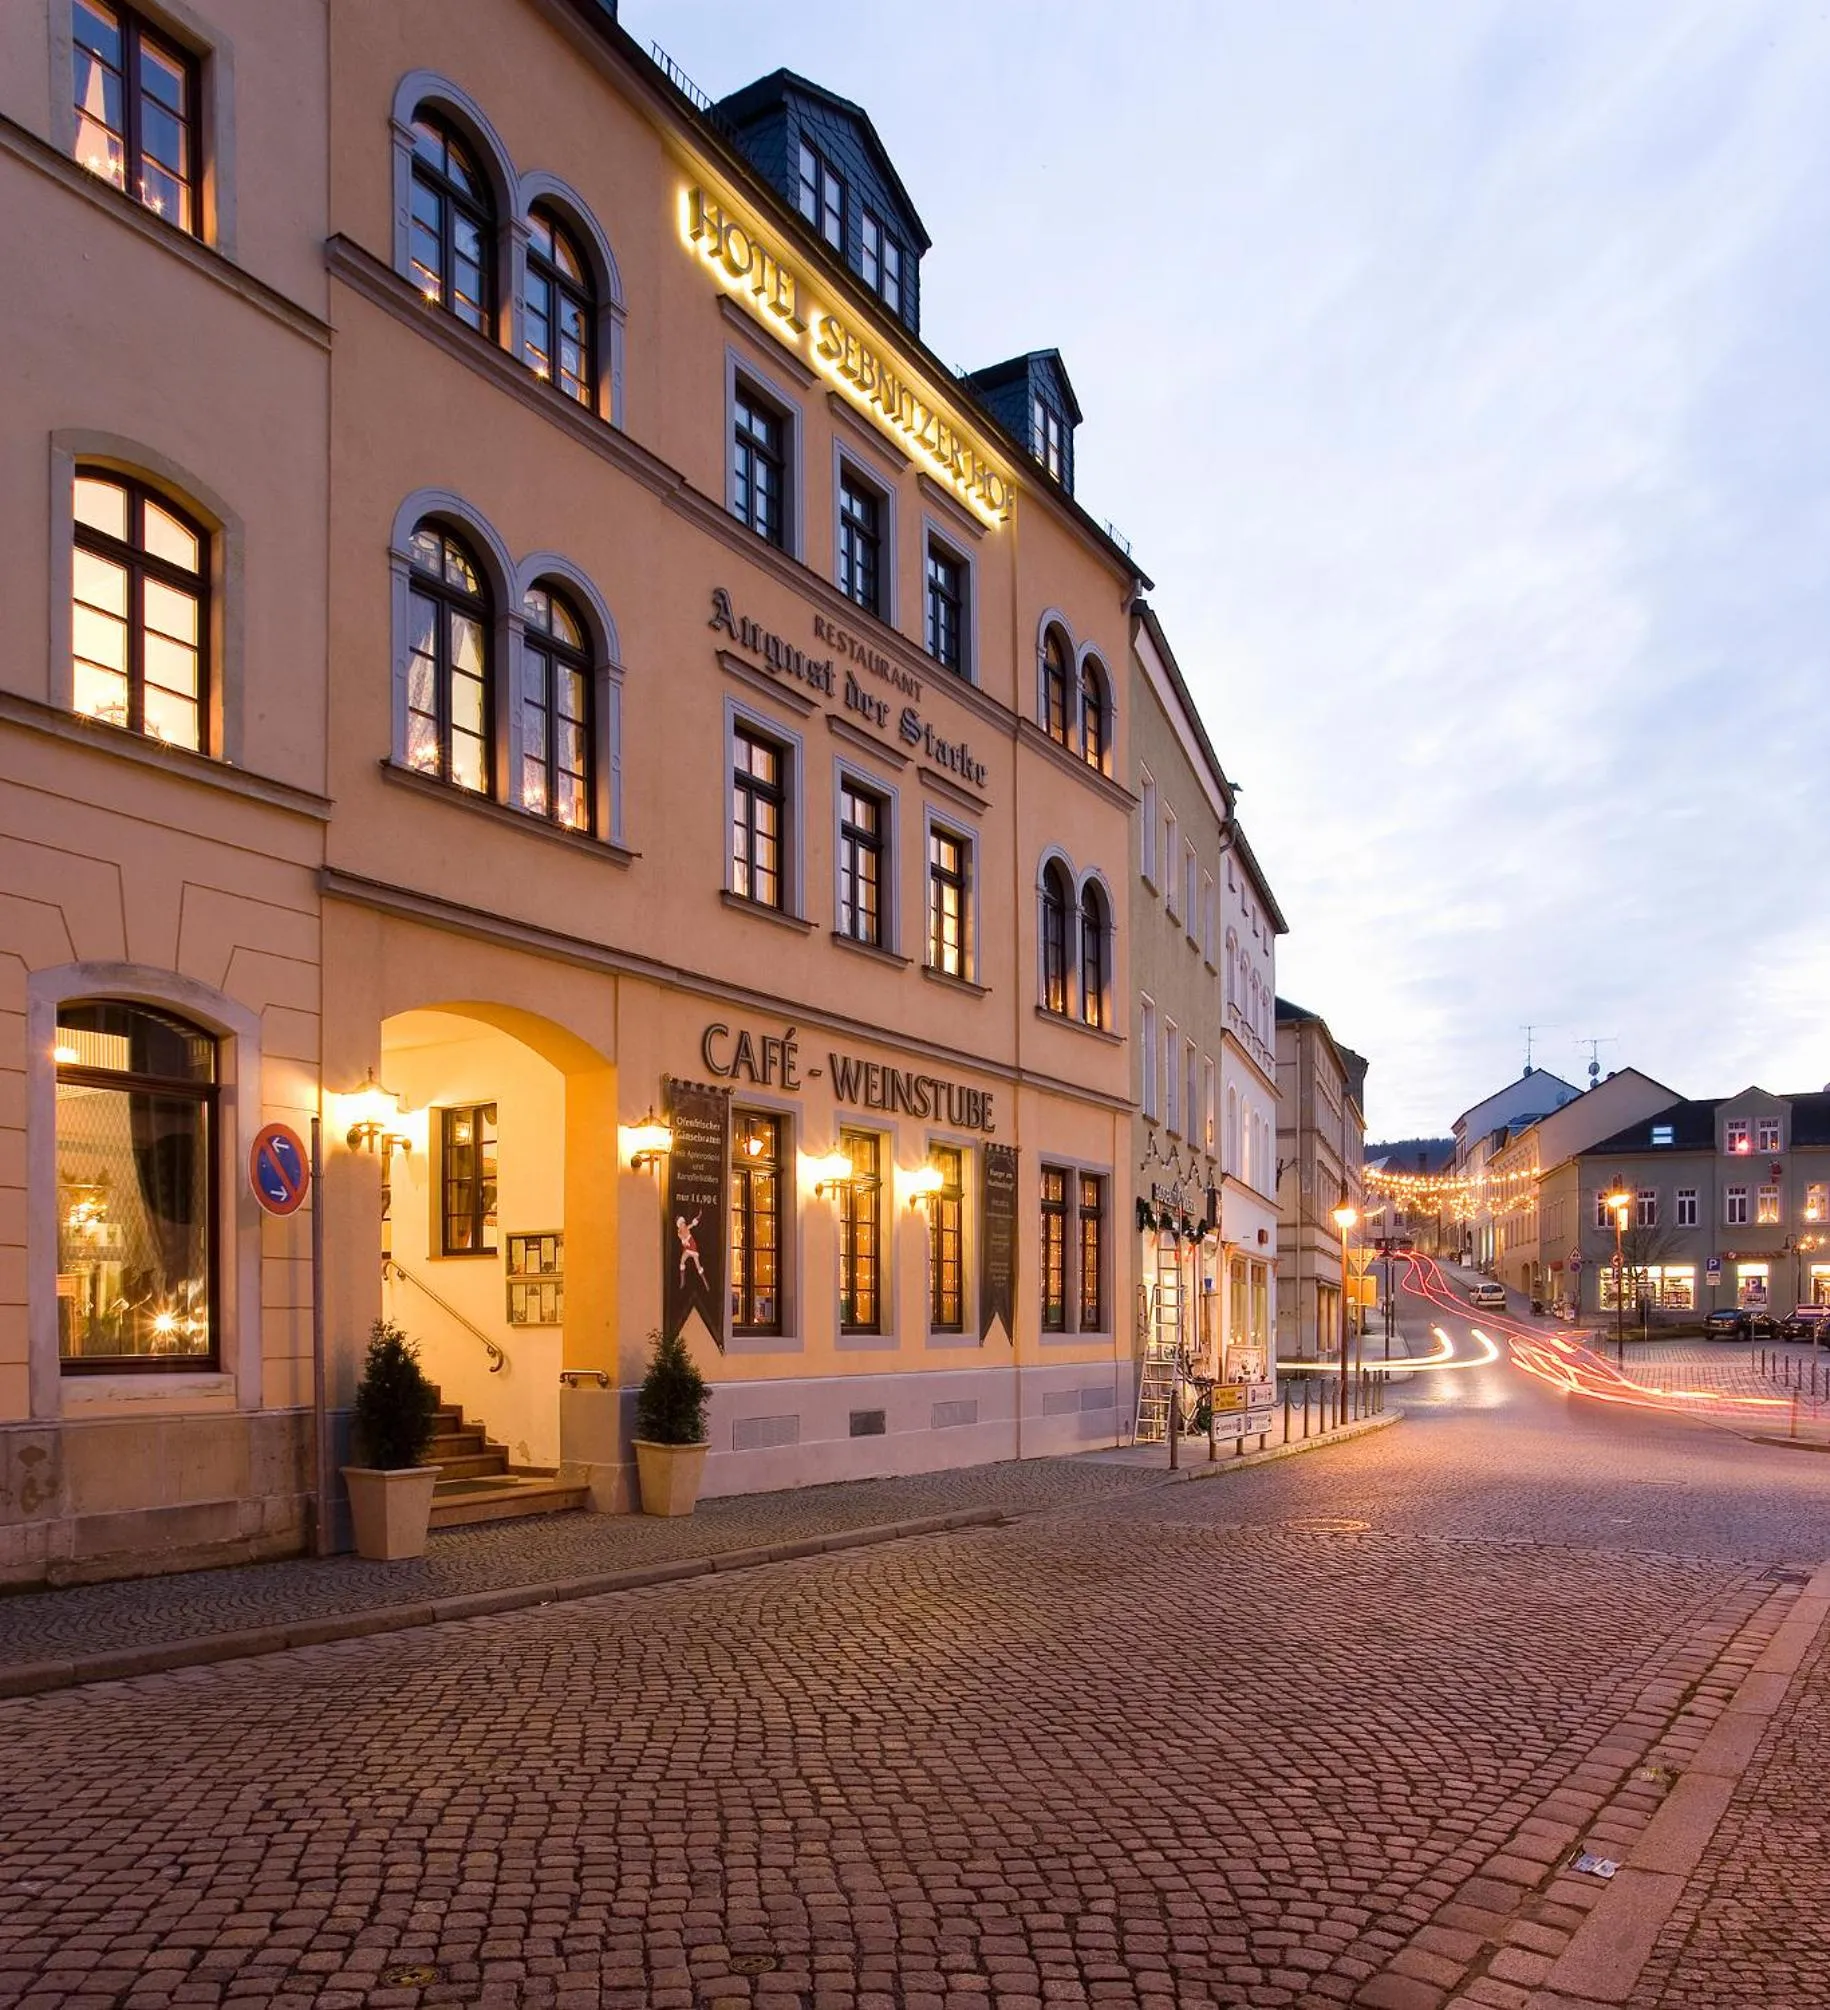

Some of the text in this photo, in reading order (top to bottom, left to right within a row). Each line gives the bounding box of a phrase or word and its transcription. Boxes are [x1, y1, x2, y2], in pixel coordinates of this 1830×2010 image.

[688, 187, 1015, 522] HOTEL SEBNITZER HOF
[709, 587, 988, 788] August der Starke
[814, 614, 923, 702] RESTAURANT
[703, 1023, 800, 1091] CAFÉ
[831, 1053, 995, 1132] WEINSTUBE
